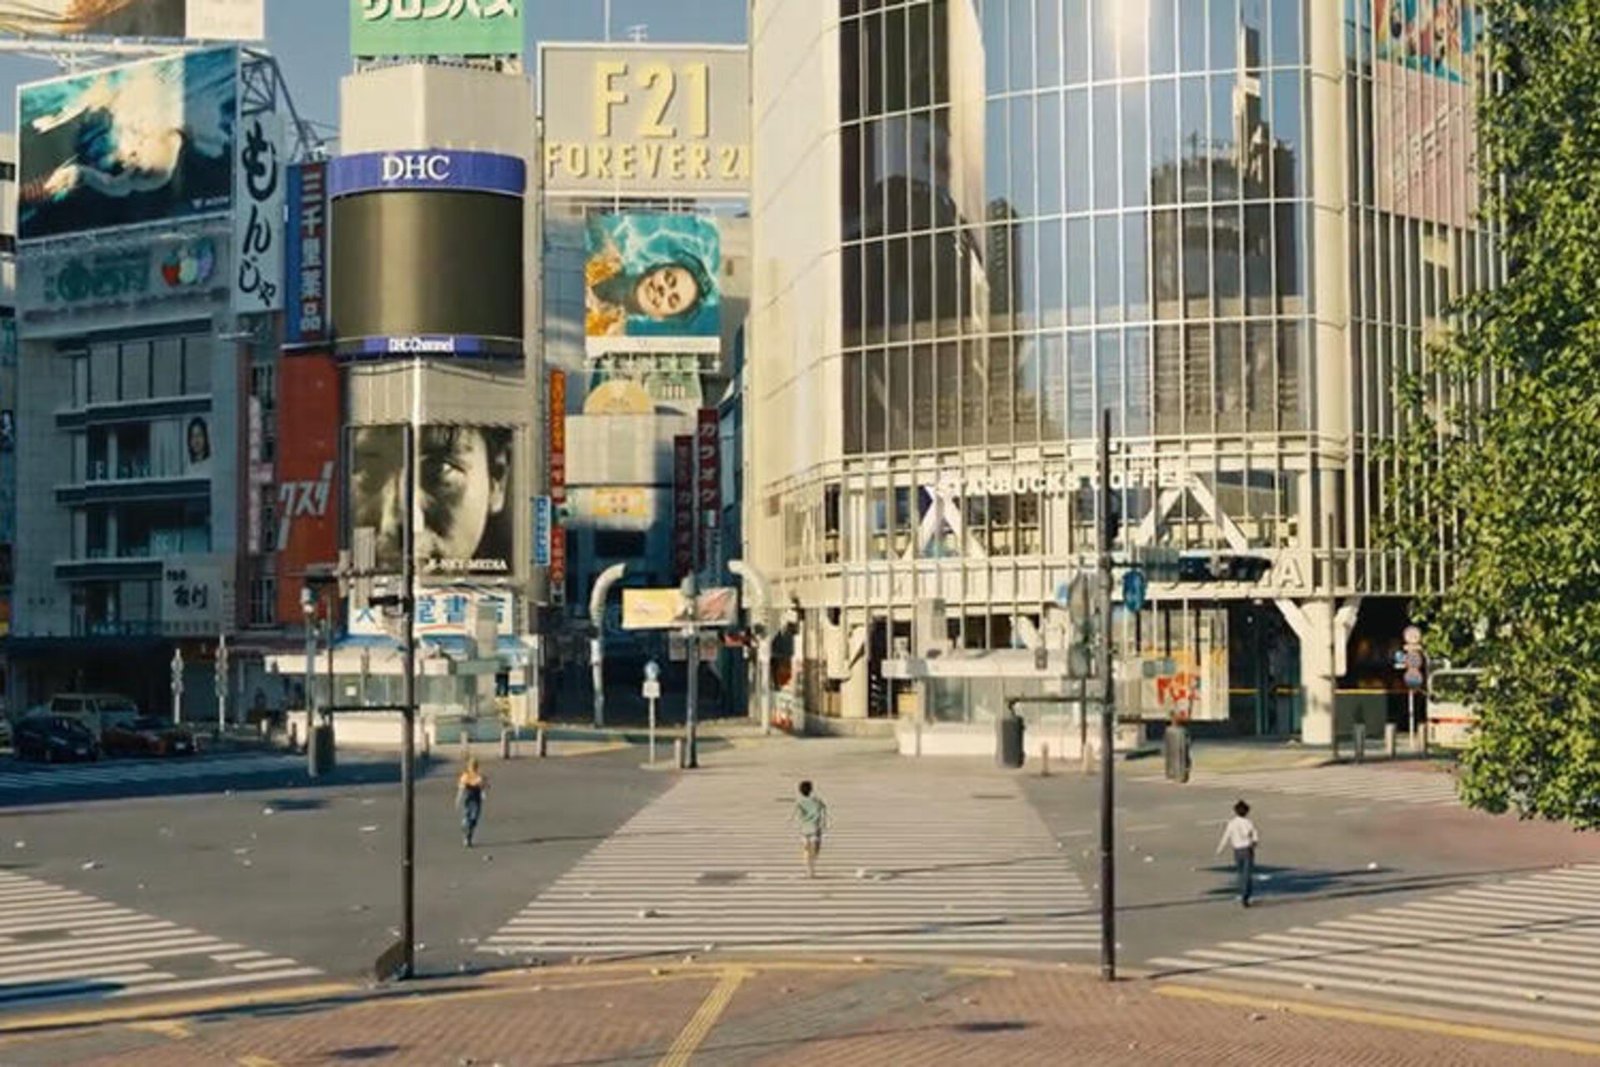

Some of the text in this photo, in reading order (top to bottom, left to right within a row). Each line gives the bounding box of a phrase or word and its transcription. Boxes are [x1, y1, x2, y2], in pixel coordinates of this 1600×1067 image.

[596, 61, 709, 138] F21
[382, 155, 450, 181] DHC
[546, 142, 710, 179] FOREVER
[238, 120, 278, 307] もんじゃ
